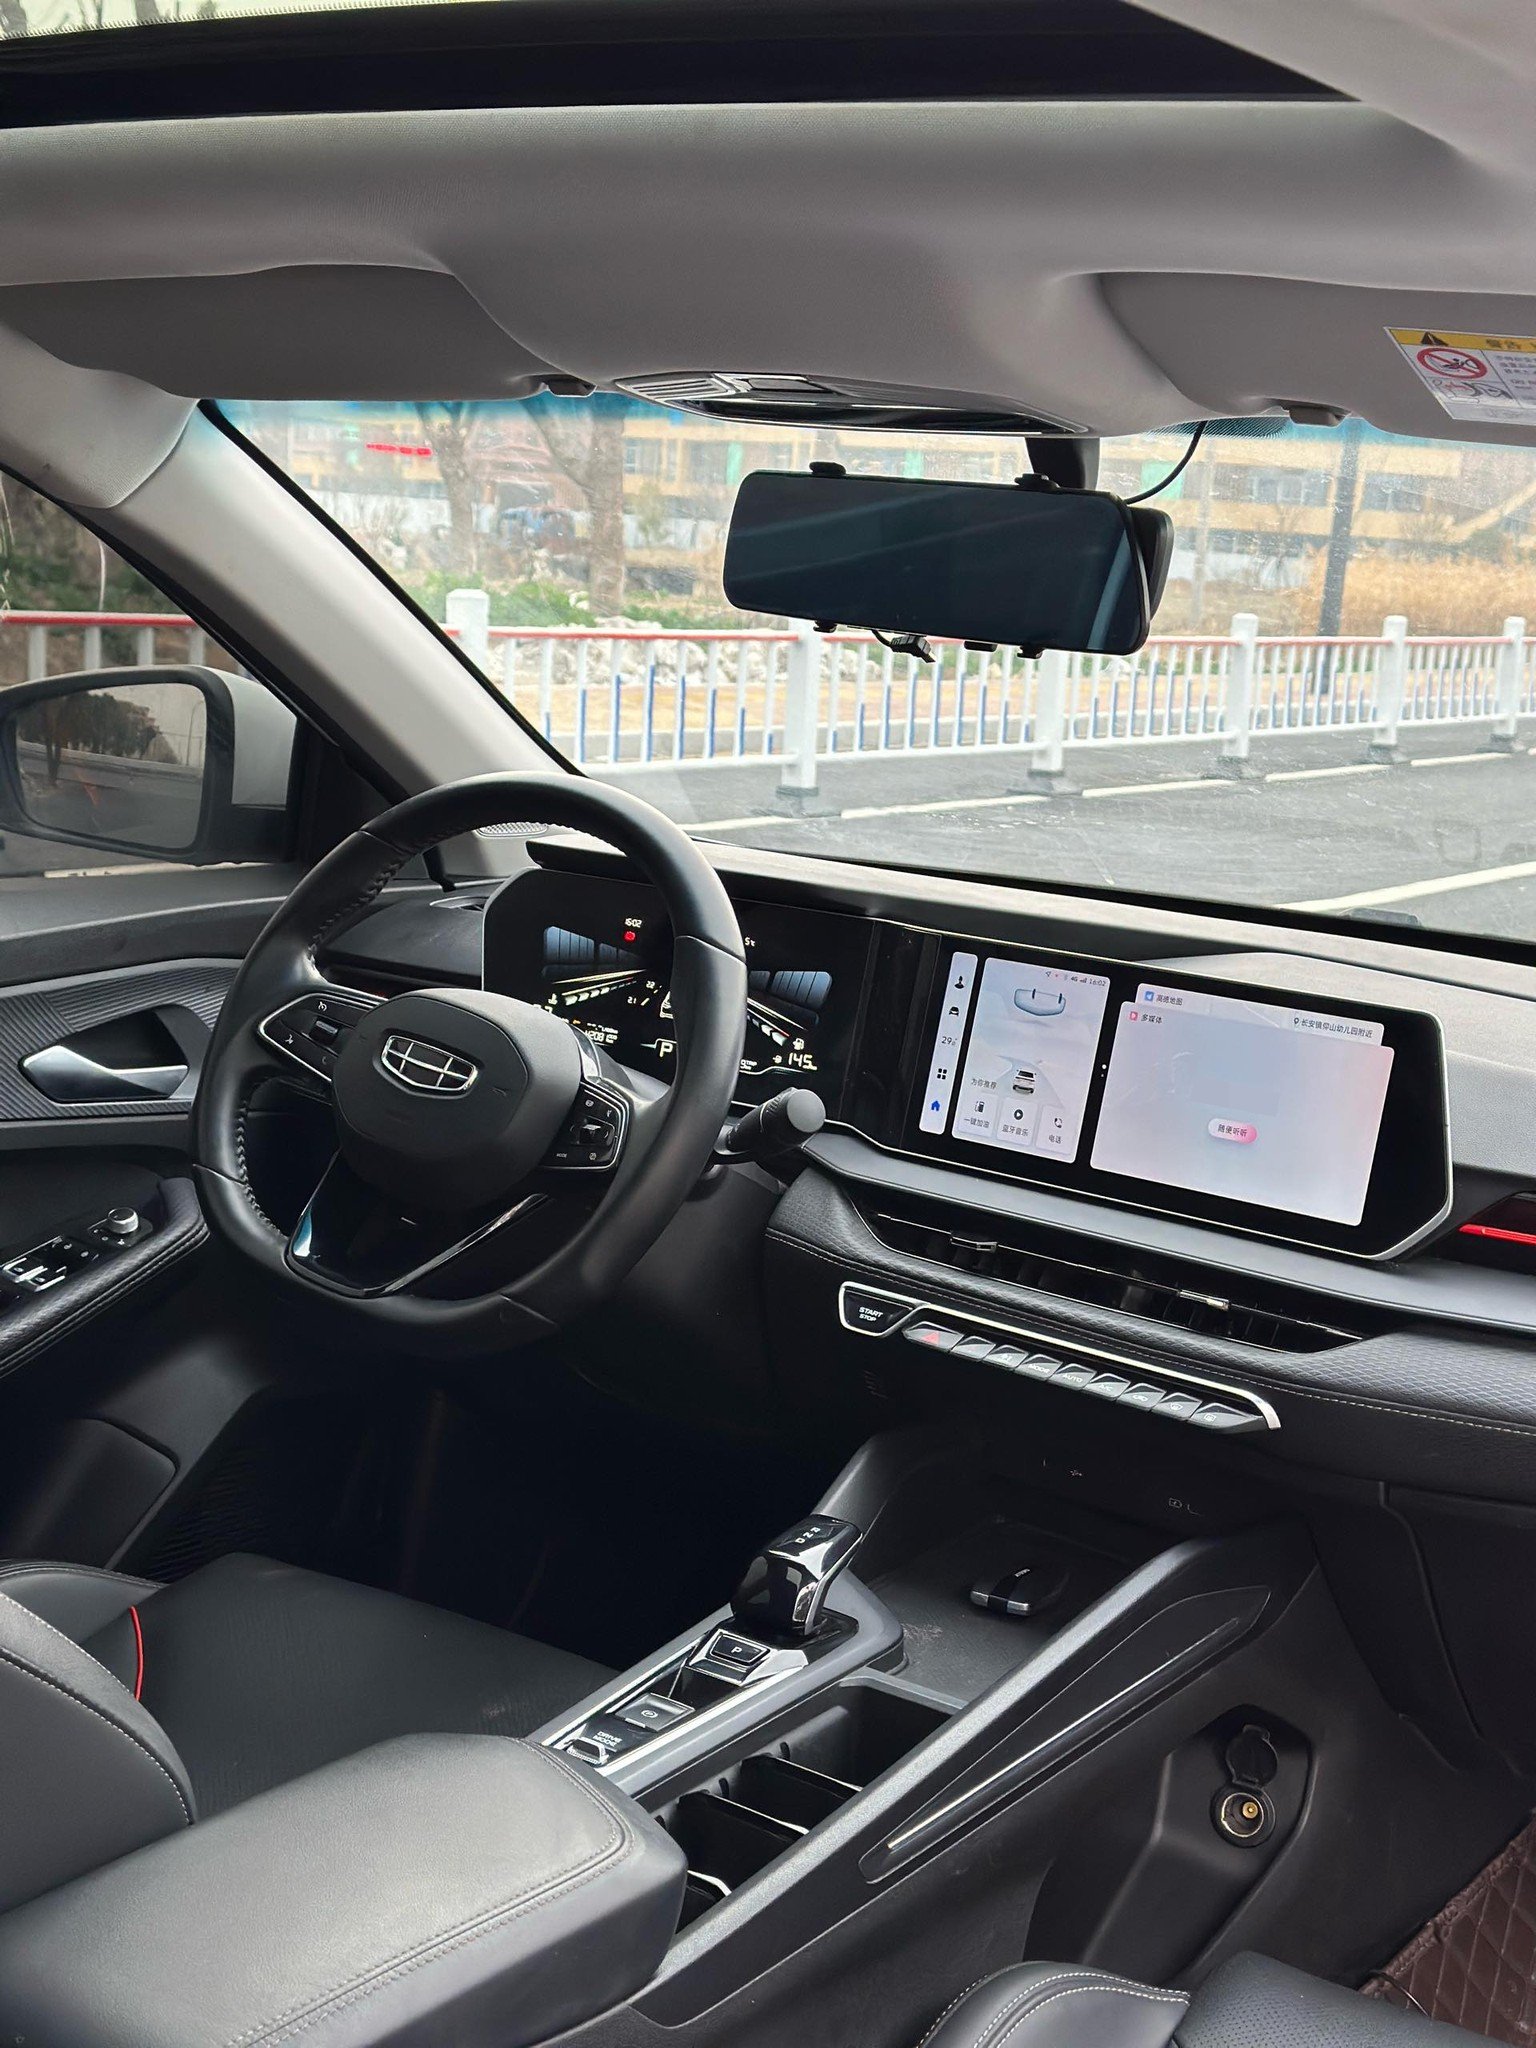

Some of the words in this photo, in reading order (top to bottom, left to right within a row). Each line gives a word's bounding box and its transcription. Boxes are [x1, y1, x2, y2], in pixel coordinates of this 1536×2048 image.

[1089, 978, 1107, 987] 16:02
[1140, 1013, 1162, 1024] 多媒体
[659, 1041, 674, 1058] P
[971, 1078, 997, 1090] 为你推荐
[963, 1117, 990, 1129] 一键加油
[1001, 1124, 1029, 1137] 蓝牙音乐
[1217, 1123, 1248, 1137] 随便听听
[1048, 1134, 1062, 1145] 电话
[858, 1306, 884, 1318] START
[858, 1313, 877, 1322] STOP
[1028, 1363, 1051, 1374] MODE
[1062, 1374, 1084, 1383] AUTO
[730, 1646, 743, 1654] P
[592, 1734, 618, 1747] MODE
[597, 1730, 623, 1743] DRIVE
